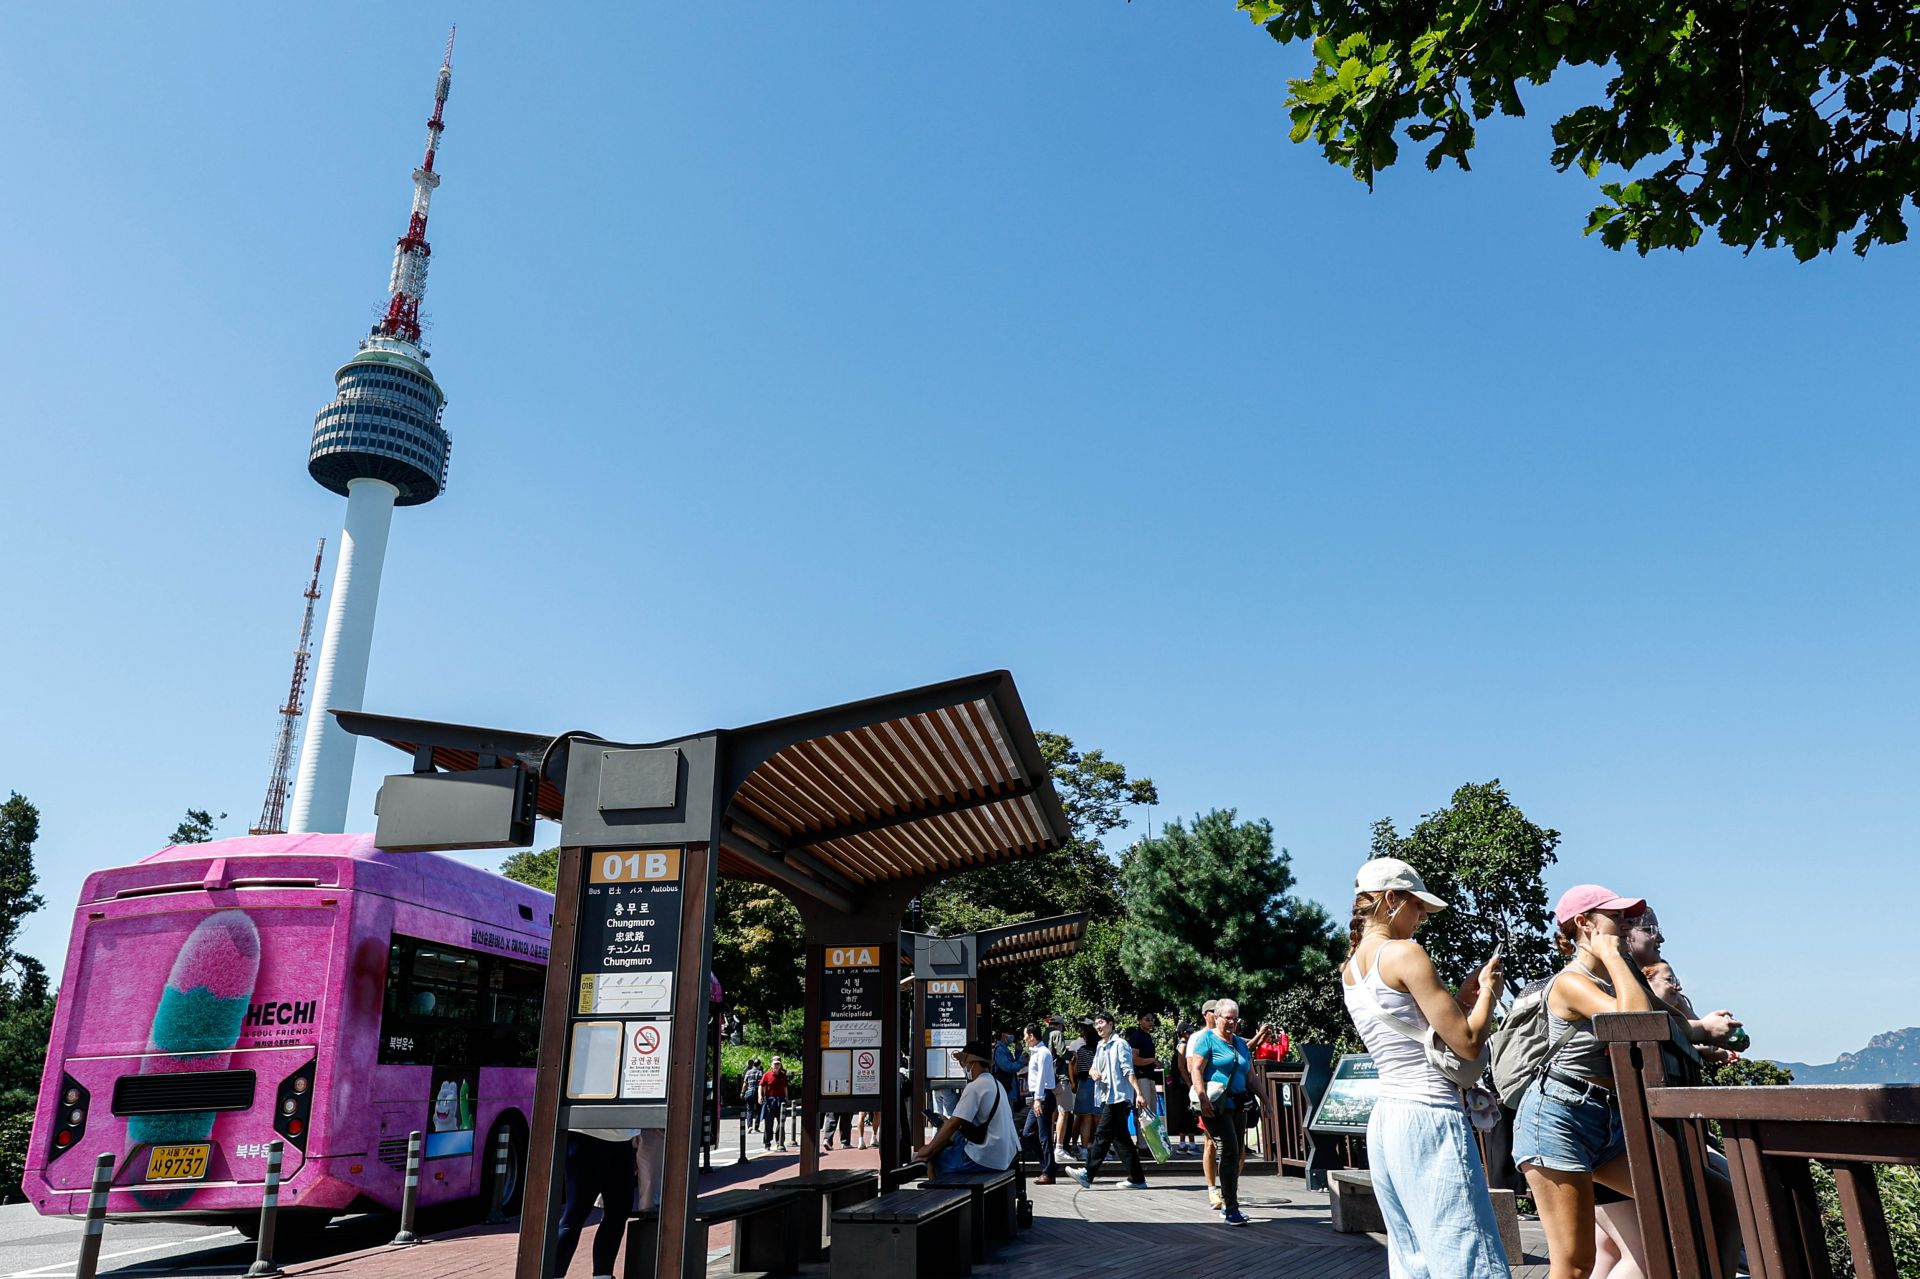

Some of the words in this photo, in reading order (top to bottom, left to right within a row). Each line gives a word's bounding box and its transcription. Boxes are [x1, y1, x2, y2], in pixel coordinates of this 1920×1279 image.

[603, 854, 667, 880] 01B
[606, 918, 655, 928] Chungmuro
[614, 931, 644, 942] 忠武路
[607, 944, 650, 954] チュンムロ
[604, 957, 652, 967] Chungmuro
[832, 950, 872, 965] 01A
[932, 982, 959, 993] 01A
[246, 1000, 316, 1026] HECHI
[390, 1037, 414, 1050] 북부운수
[631, 1057, 660, 1065] 금연공원
[236, 1143, 270, 1158] 북부운
